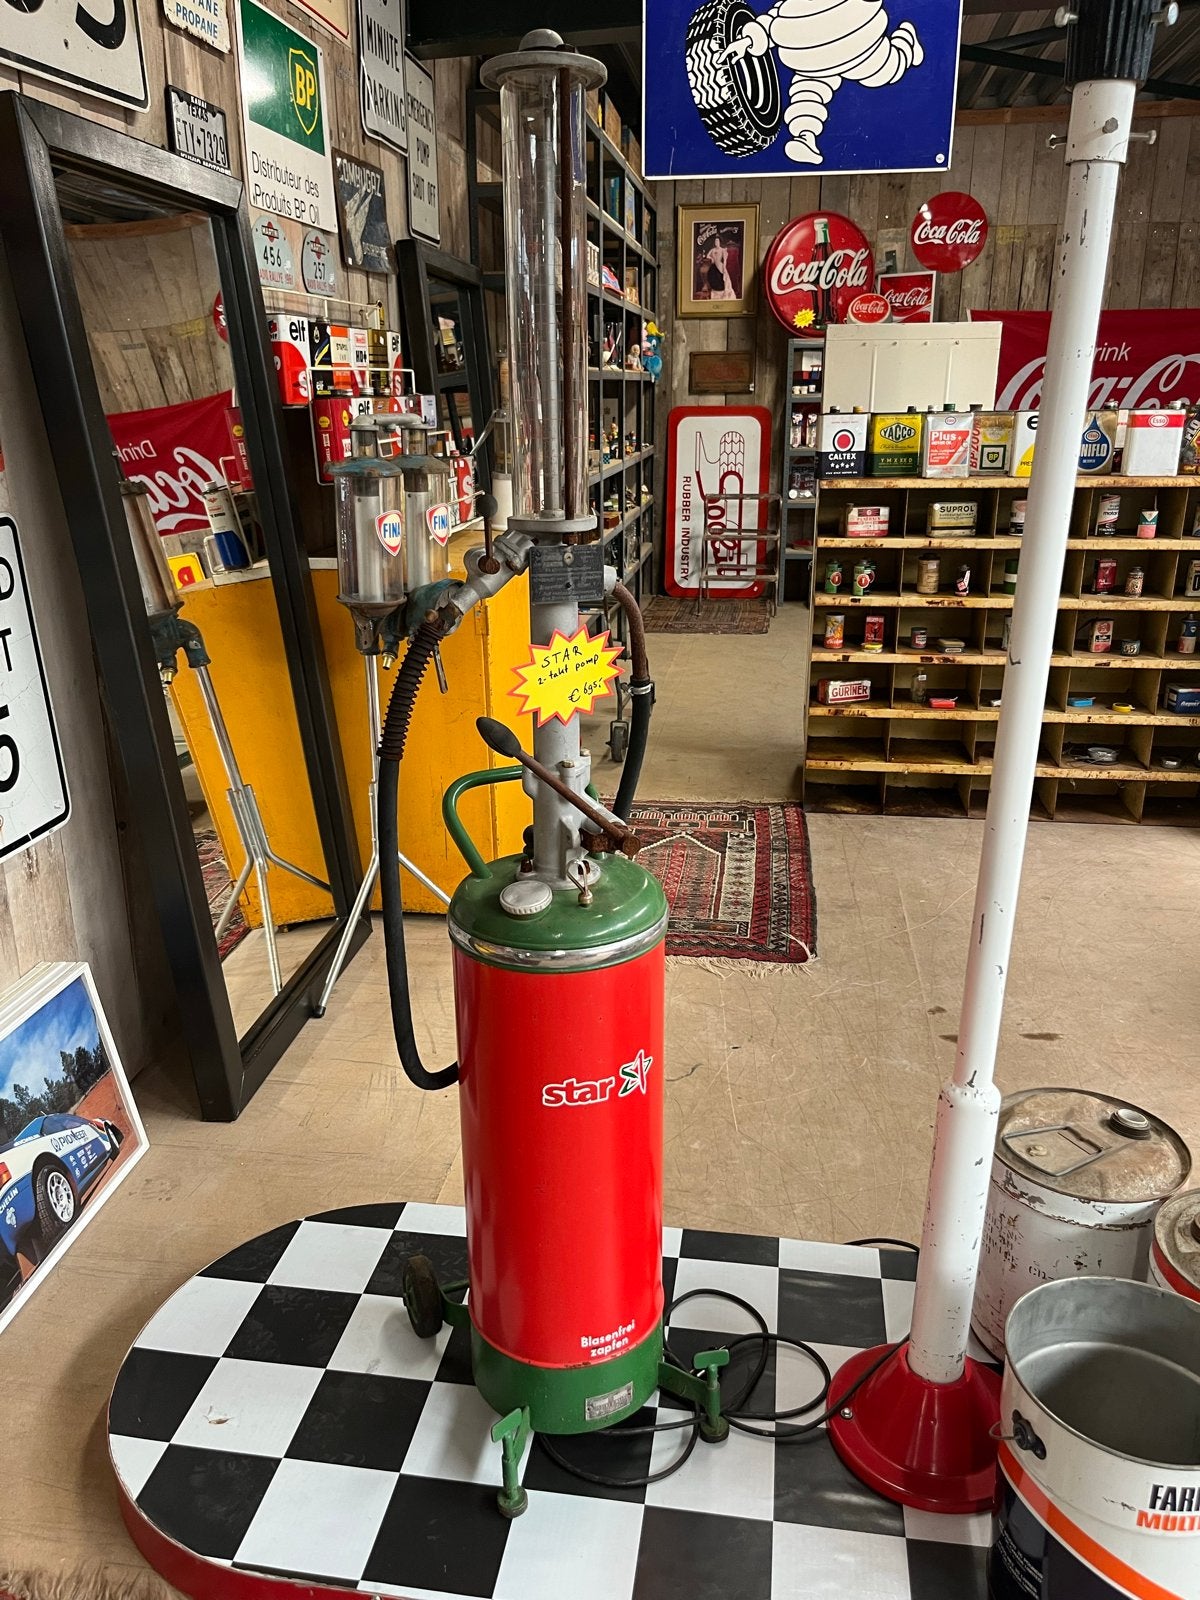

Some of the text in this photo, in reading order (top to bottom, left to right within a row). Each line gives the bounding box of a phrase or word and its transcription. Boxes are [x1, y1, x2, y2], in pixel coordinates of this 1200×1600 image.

[176, 2, 218, 39] PROPANE
[366, 14, 400, 73] MINUTE
[295, 63, 315, 111] BP
[188, 104, 208, 123] TEXAS
[366, 75, 406, 132] PARKING
[407, 92, 434, 135] EMERGENCY
[416, 137, 430, 167] PUMP
[252, 151, 320, 198] Distributeur des
[412, 172, 436, 208] SHUT OFF
[254, 183, 320, 226] Produits BP Oil
[263, 245, 282, 267] 456
[314, 261, 326, 281] 257
[770, 248, 870, 295] Coca-Cola
[289, 320, 306, 342] elf
[1094, 342, 1131, 361] rink
[358, 400, 370, 415] elf
[1152, 417, 1166, 425] Esso
[883, 424, 913, 441] YACCO
[931, 432, 957, 441] Plus
[828, 453, 857, 461] CALTEX
[1081, 444, 1107, 457] NIFLO
[940, 505, 975, 513] SUPROL
[680, 476, 691, 581] RUBBER INDUSTRY
[541, 645, 583, 669] STAR
[575, 654, 599, 673] pomp
[542, 1076, 615, 1107] star
[59, 1129, 87, 1147] PIONEER
[580, 1319, 636, 1348] Blasenfrei
[590, 1337, 629, 1357] zapfen
